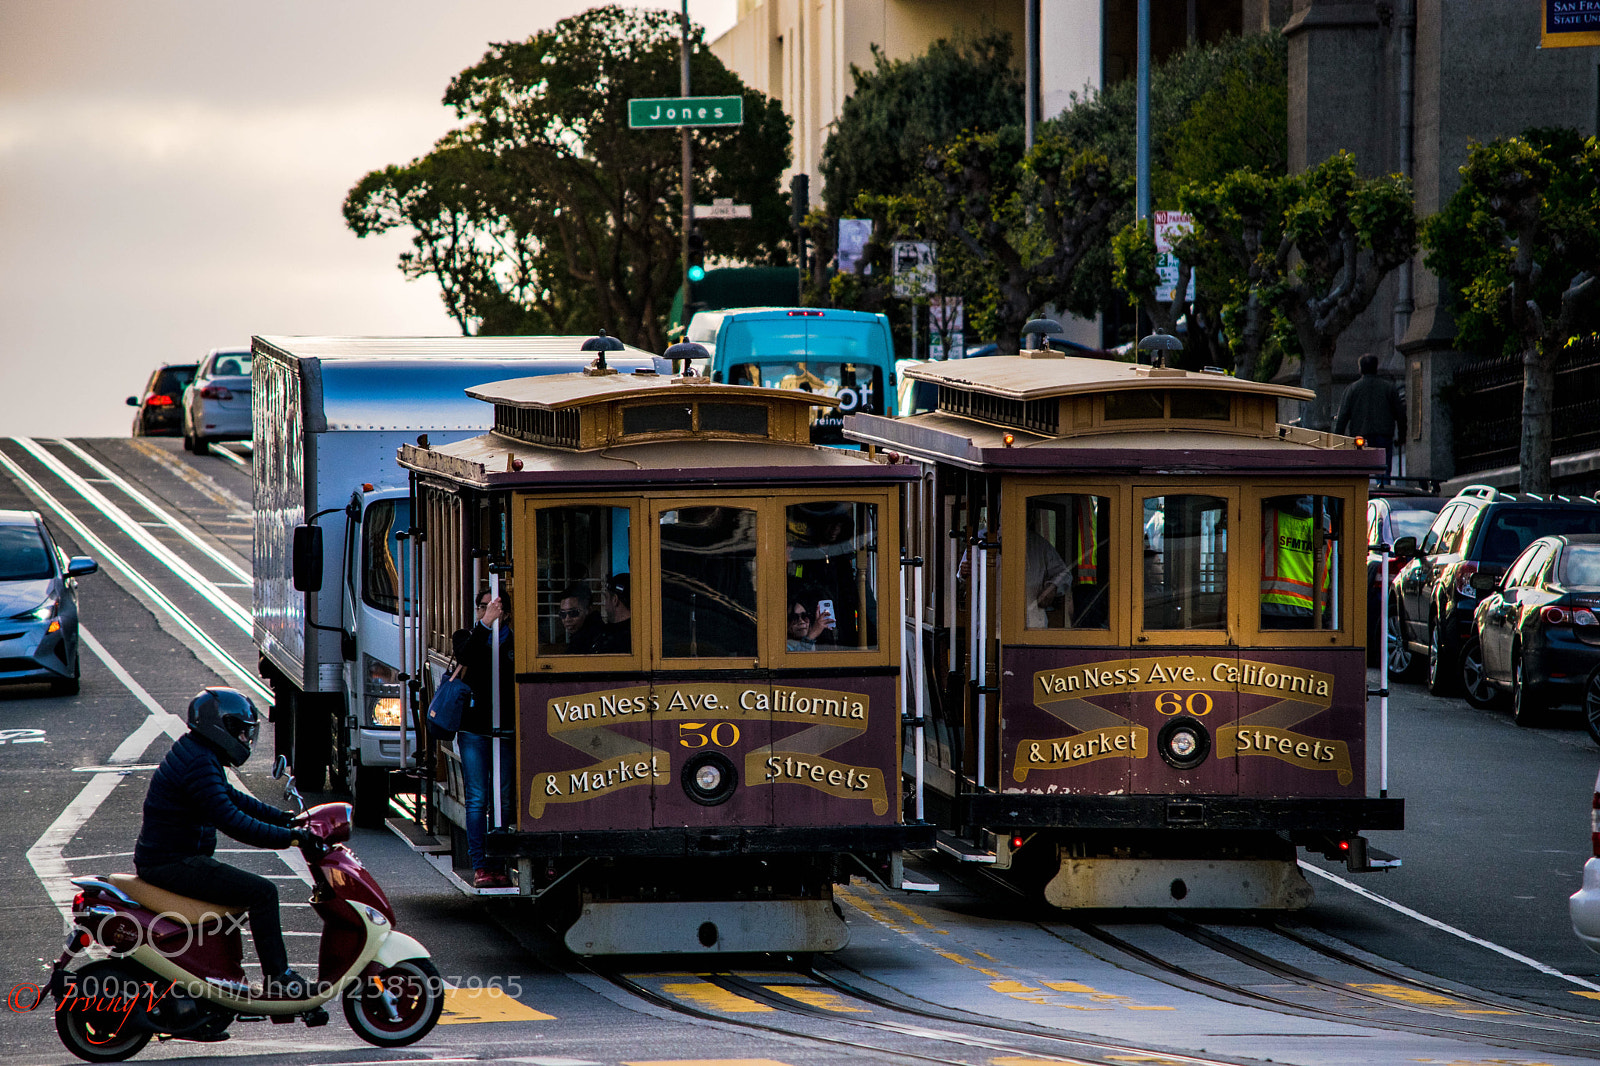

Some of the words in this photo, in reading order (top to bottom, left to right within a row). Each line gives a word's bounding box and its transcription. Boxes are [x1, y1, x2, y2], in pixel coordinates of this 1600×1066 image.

[1554, 1, 1576, 12] SAN
[1579, 1, 1600, 11] FRA
[1554, 15, 1581, 24] STATE
[650, 105, 725, 120] Jones
[1156, 212, 1167, 223] NO
[1158, 254, 1166, 265] 2
[1280, 536, 1312, 551] SFMTA
[1211, 662, 1330, 698] California
[739, 689, 866, 720] California
[1154, 691, 1214, 716] 60
[678, 721, 741, 748] 50
[1028, 743, 1046, 763] &
[1051, 730, 1137, 763] Market
[1235, 729, 1335, 762] Streets
[545, 774, 562, 796] &
[569, 756, 660, 795] Market
[765, 755, 870, 791] Streets
